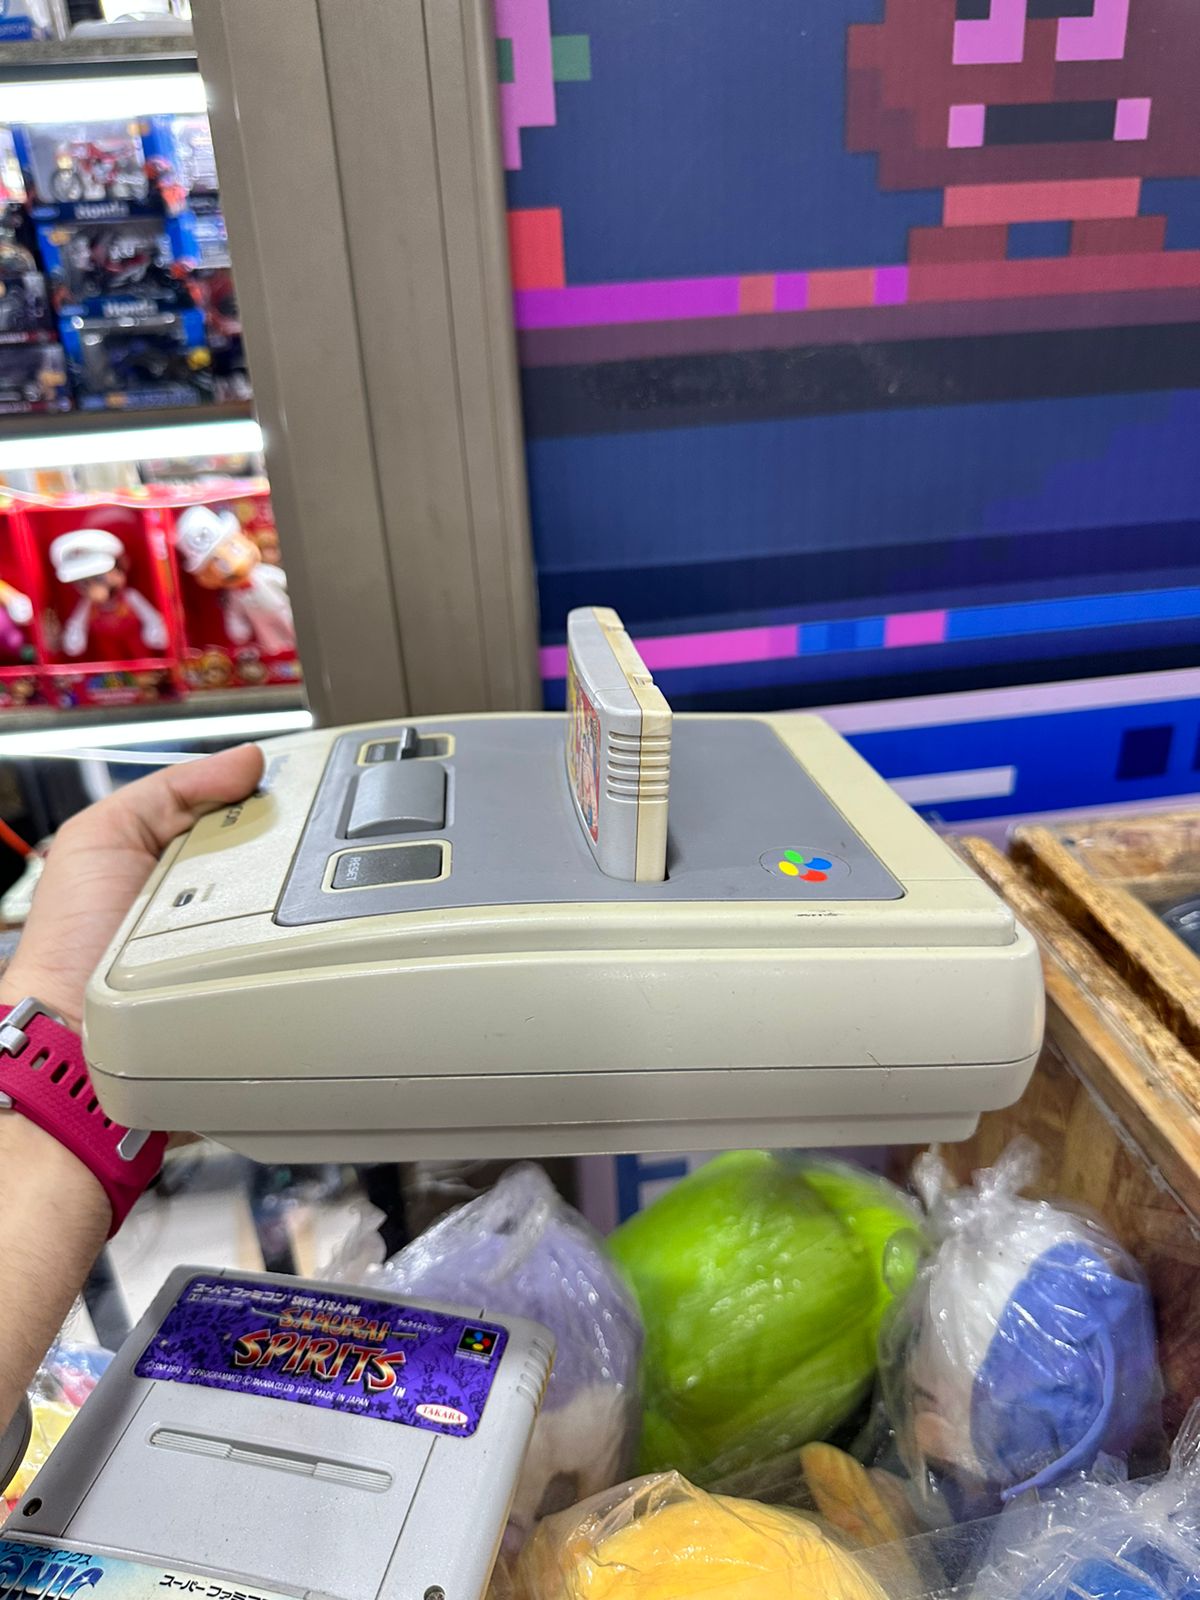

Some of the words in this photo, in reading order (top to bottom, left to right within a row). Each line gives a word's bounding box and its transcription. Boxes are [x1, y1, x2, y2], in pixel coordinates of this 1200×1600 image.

[346, 856, 361, 881] RESET
[192, 1283, 287, 1303] スーパーファミコン
[279, 1308, 390, 1342] SAMURAI
[234, 1329, 406, 1390] SPIRITS
[187, 1367, 242, 1383] REPROGRAMMED
[314, 1388, 334, 1400] MADE
[336, 1392, 346, 1402] IN
[345, 1396, 370, 1408] JAPAN
[392, 1385, 406, 1398] TM
[422, 1406, 462, 1422] TAKARA
